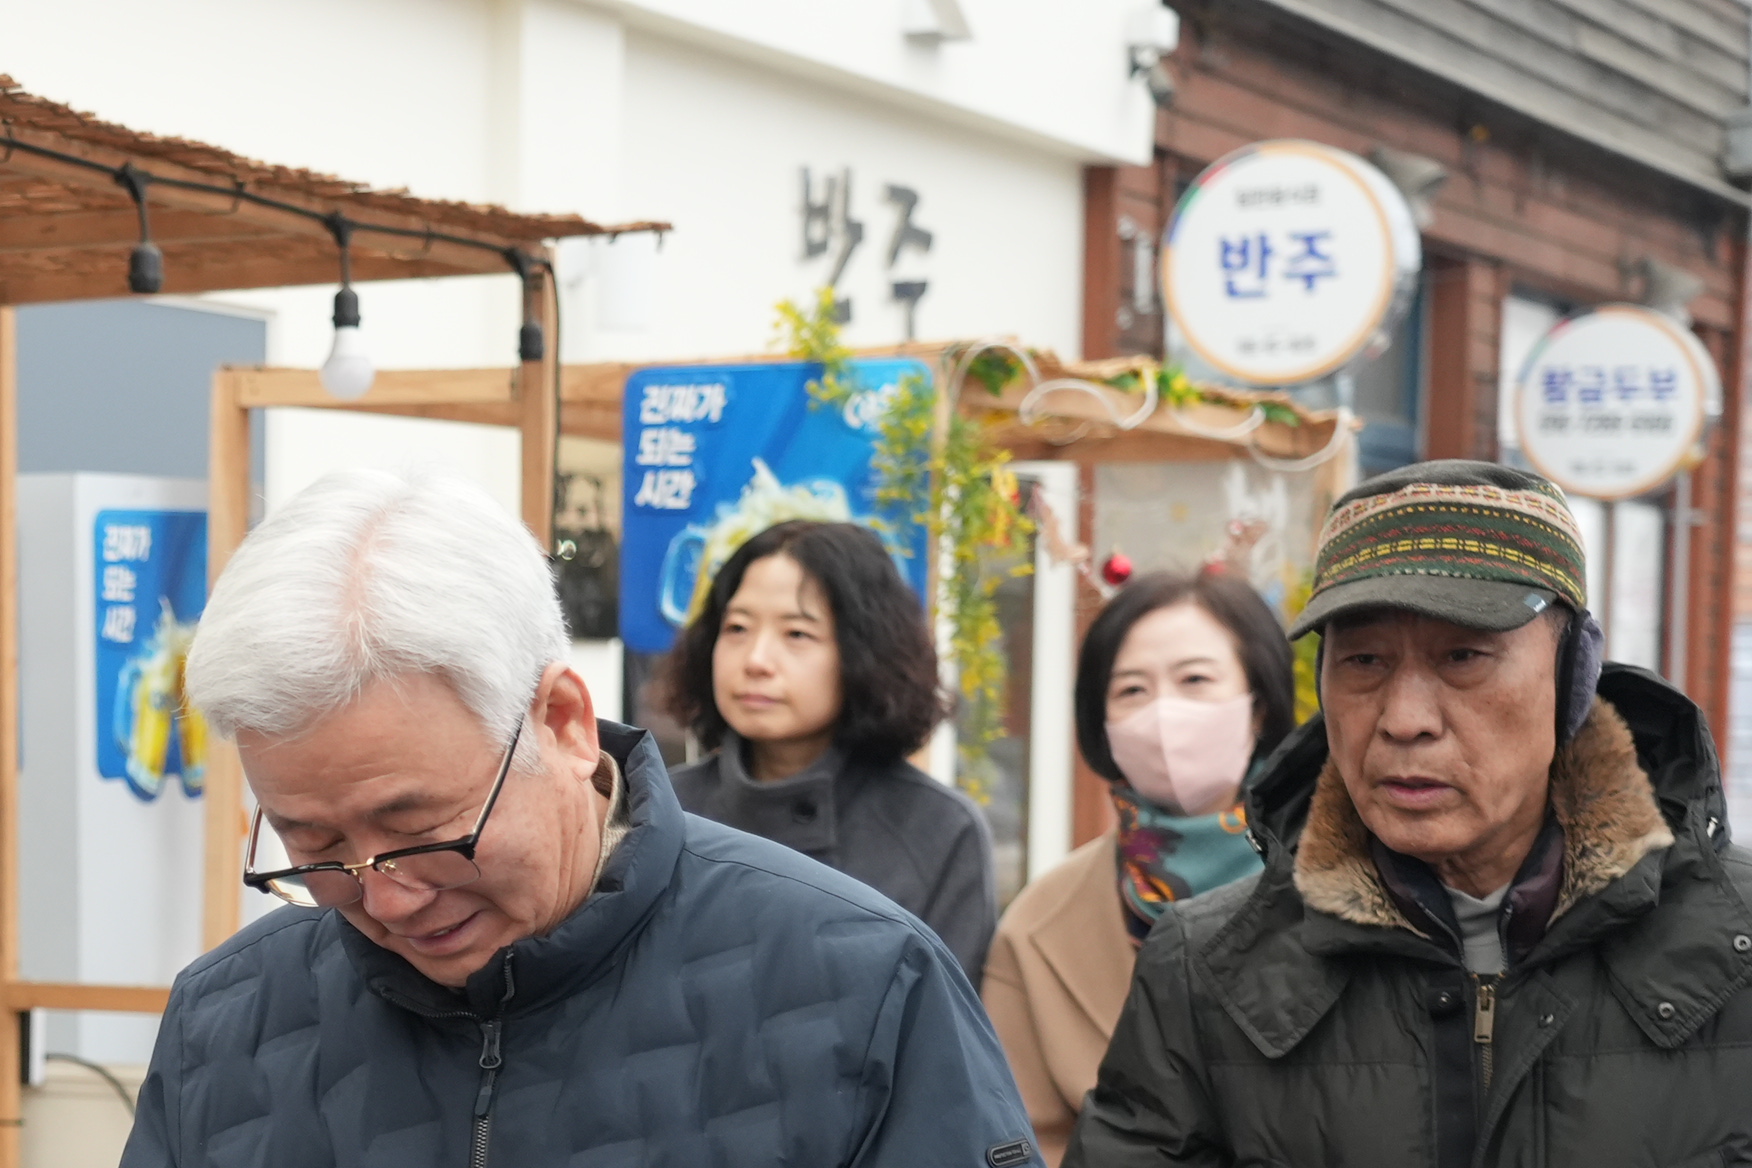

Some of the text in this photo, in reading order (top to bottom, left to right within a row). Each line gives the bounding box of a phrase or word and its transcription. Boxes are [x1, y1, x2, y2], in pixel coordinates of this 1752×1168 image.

[1219, 231, 1339, 300] 반주
[639, 383, 727, 425] 진짜가
[635, 426, 696, 467] 되는
[634, 468, 696, 510] 시간
